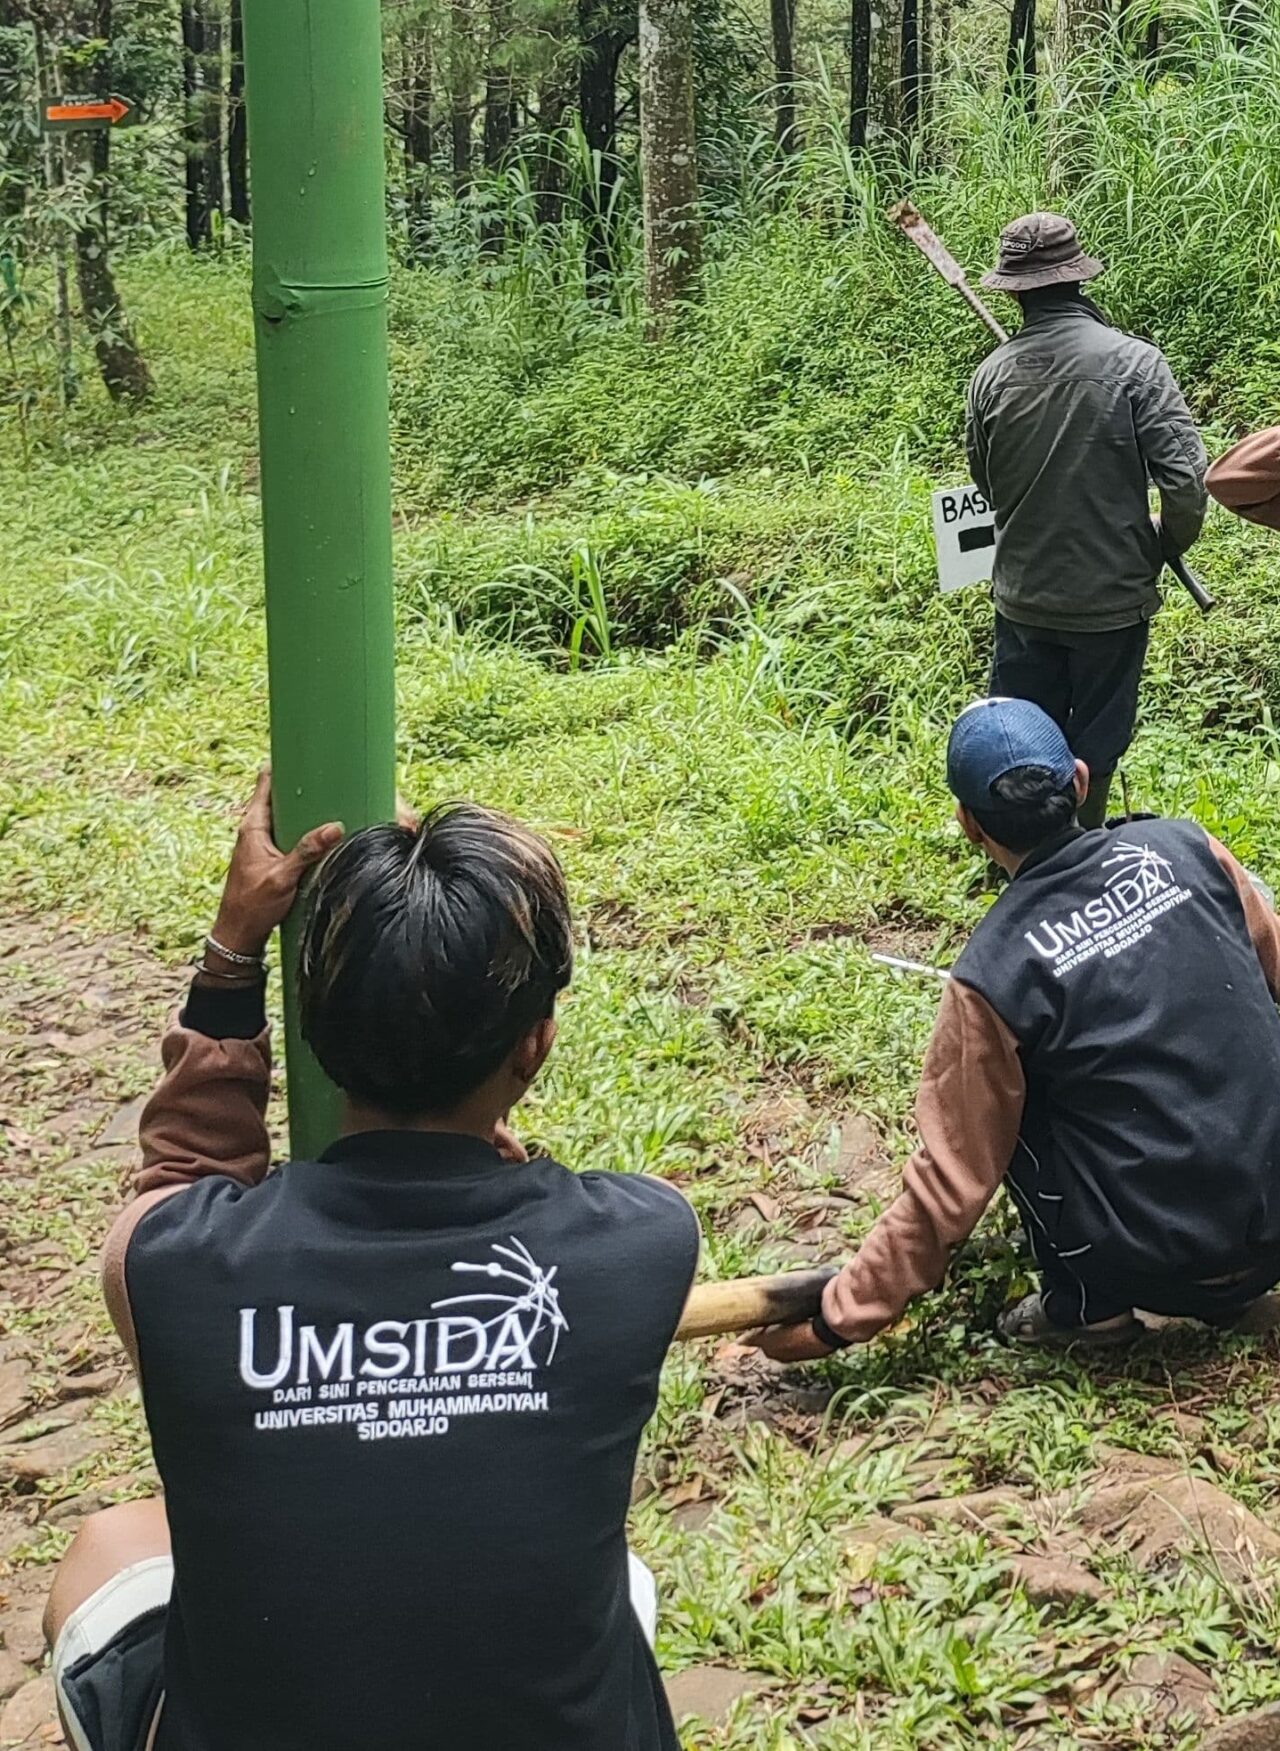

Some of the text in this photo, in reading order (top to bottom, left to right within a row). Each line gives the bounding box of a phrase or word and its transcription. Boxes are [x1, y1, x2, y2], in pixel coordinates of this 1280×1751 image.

[1024, 868, 1171, 958] UMSIDA
[1095, 910, 1145, 941] PENCERAHAN
[1052, 889, 1193, 978] UNIVERSITAS MUHAMMADIYAH
[1103, 924, 1153, 959] SIDOARJO
[239, 1305, 538, 1389] UMSIDA
[272, 1371, 534, 1404] DARI SINI PENCERAHAN BERSEMI
[254, 1391, 549, 1430] UNIVERSITAS MUHAMMADIYAH
[357, 1416, 449, 1441] SIDOARJO
